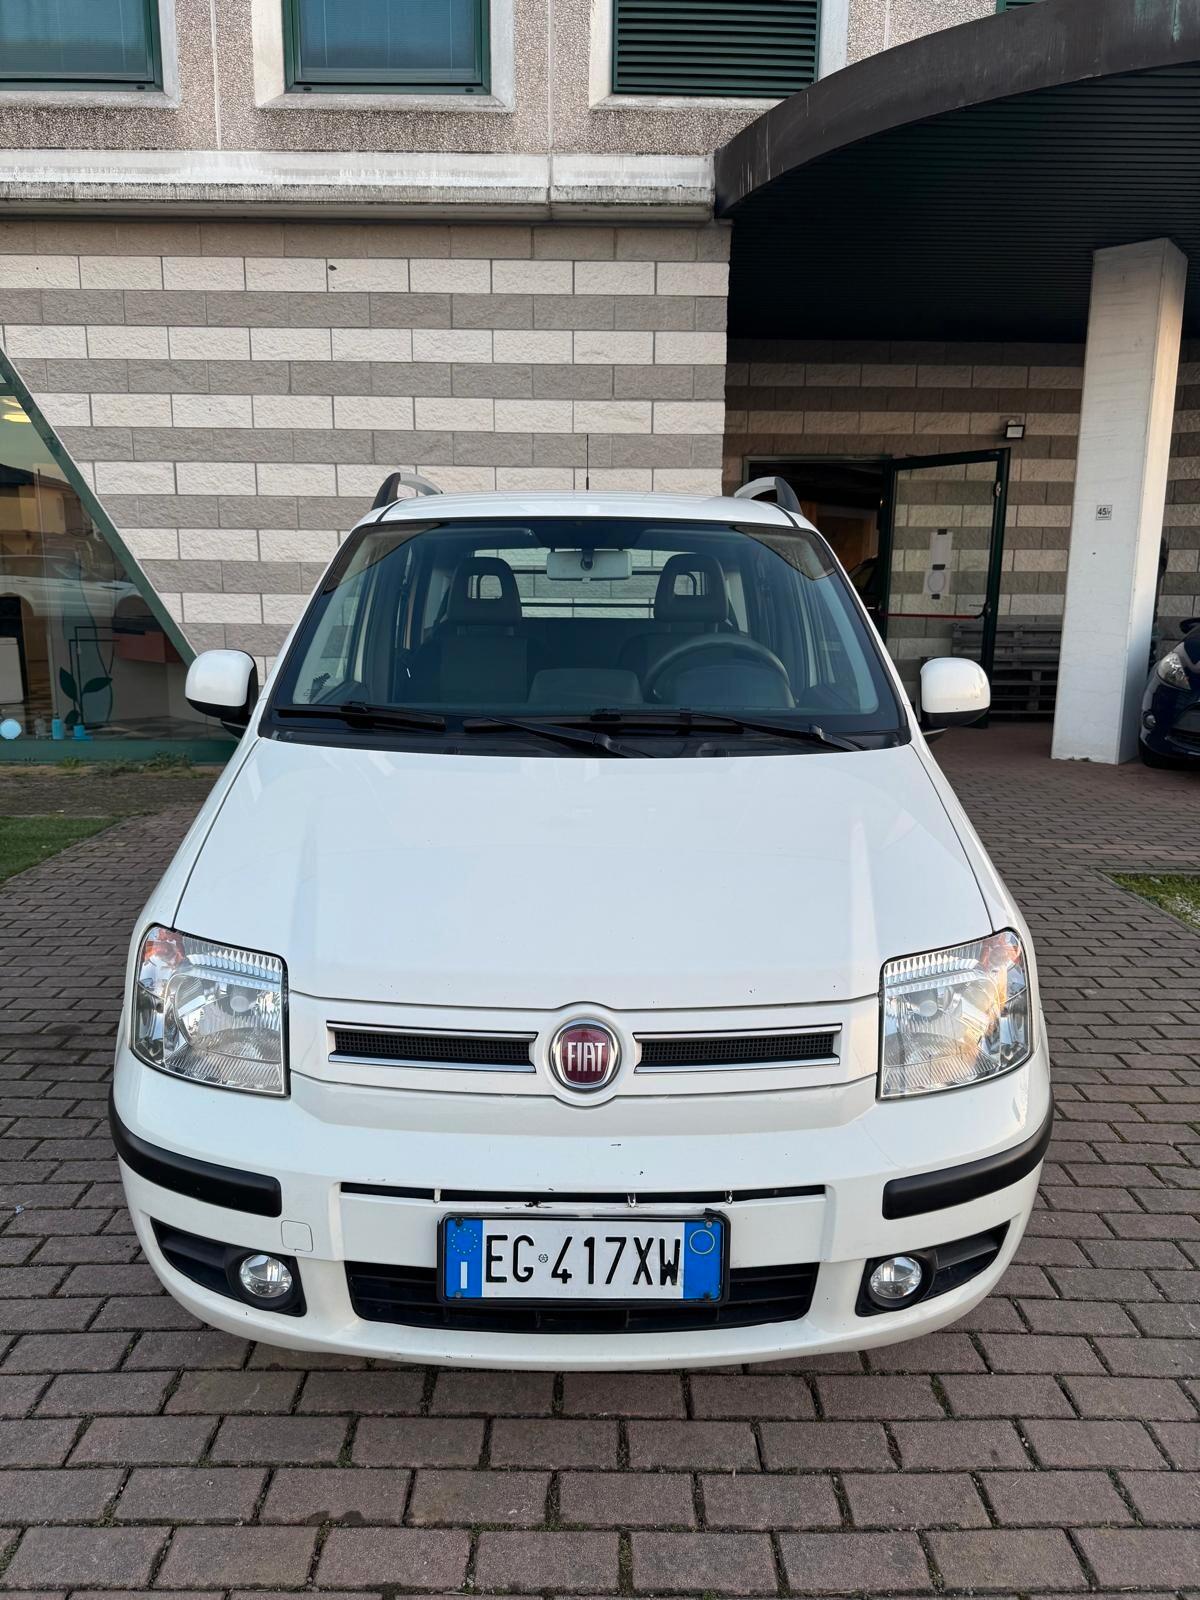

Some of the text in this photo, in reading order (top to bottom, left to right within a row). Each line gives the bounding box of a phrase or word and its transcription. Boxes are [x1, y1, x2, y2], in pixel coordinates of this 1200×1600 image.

[567, 1042, 606, 1072] FIAT
[460, 1261, 468, 1289] I
[485, 1234, 681, 1286] EG 417XW
